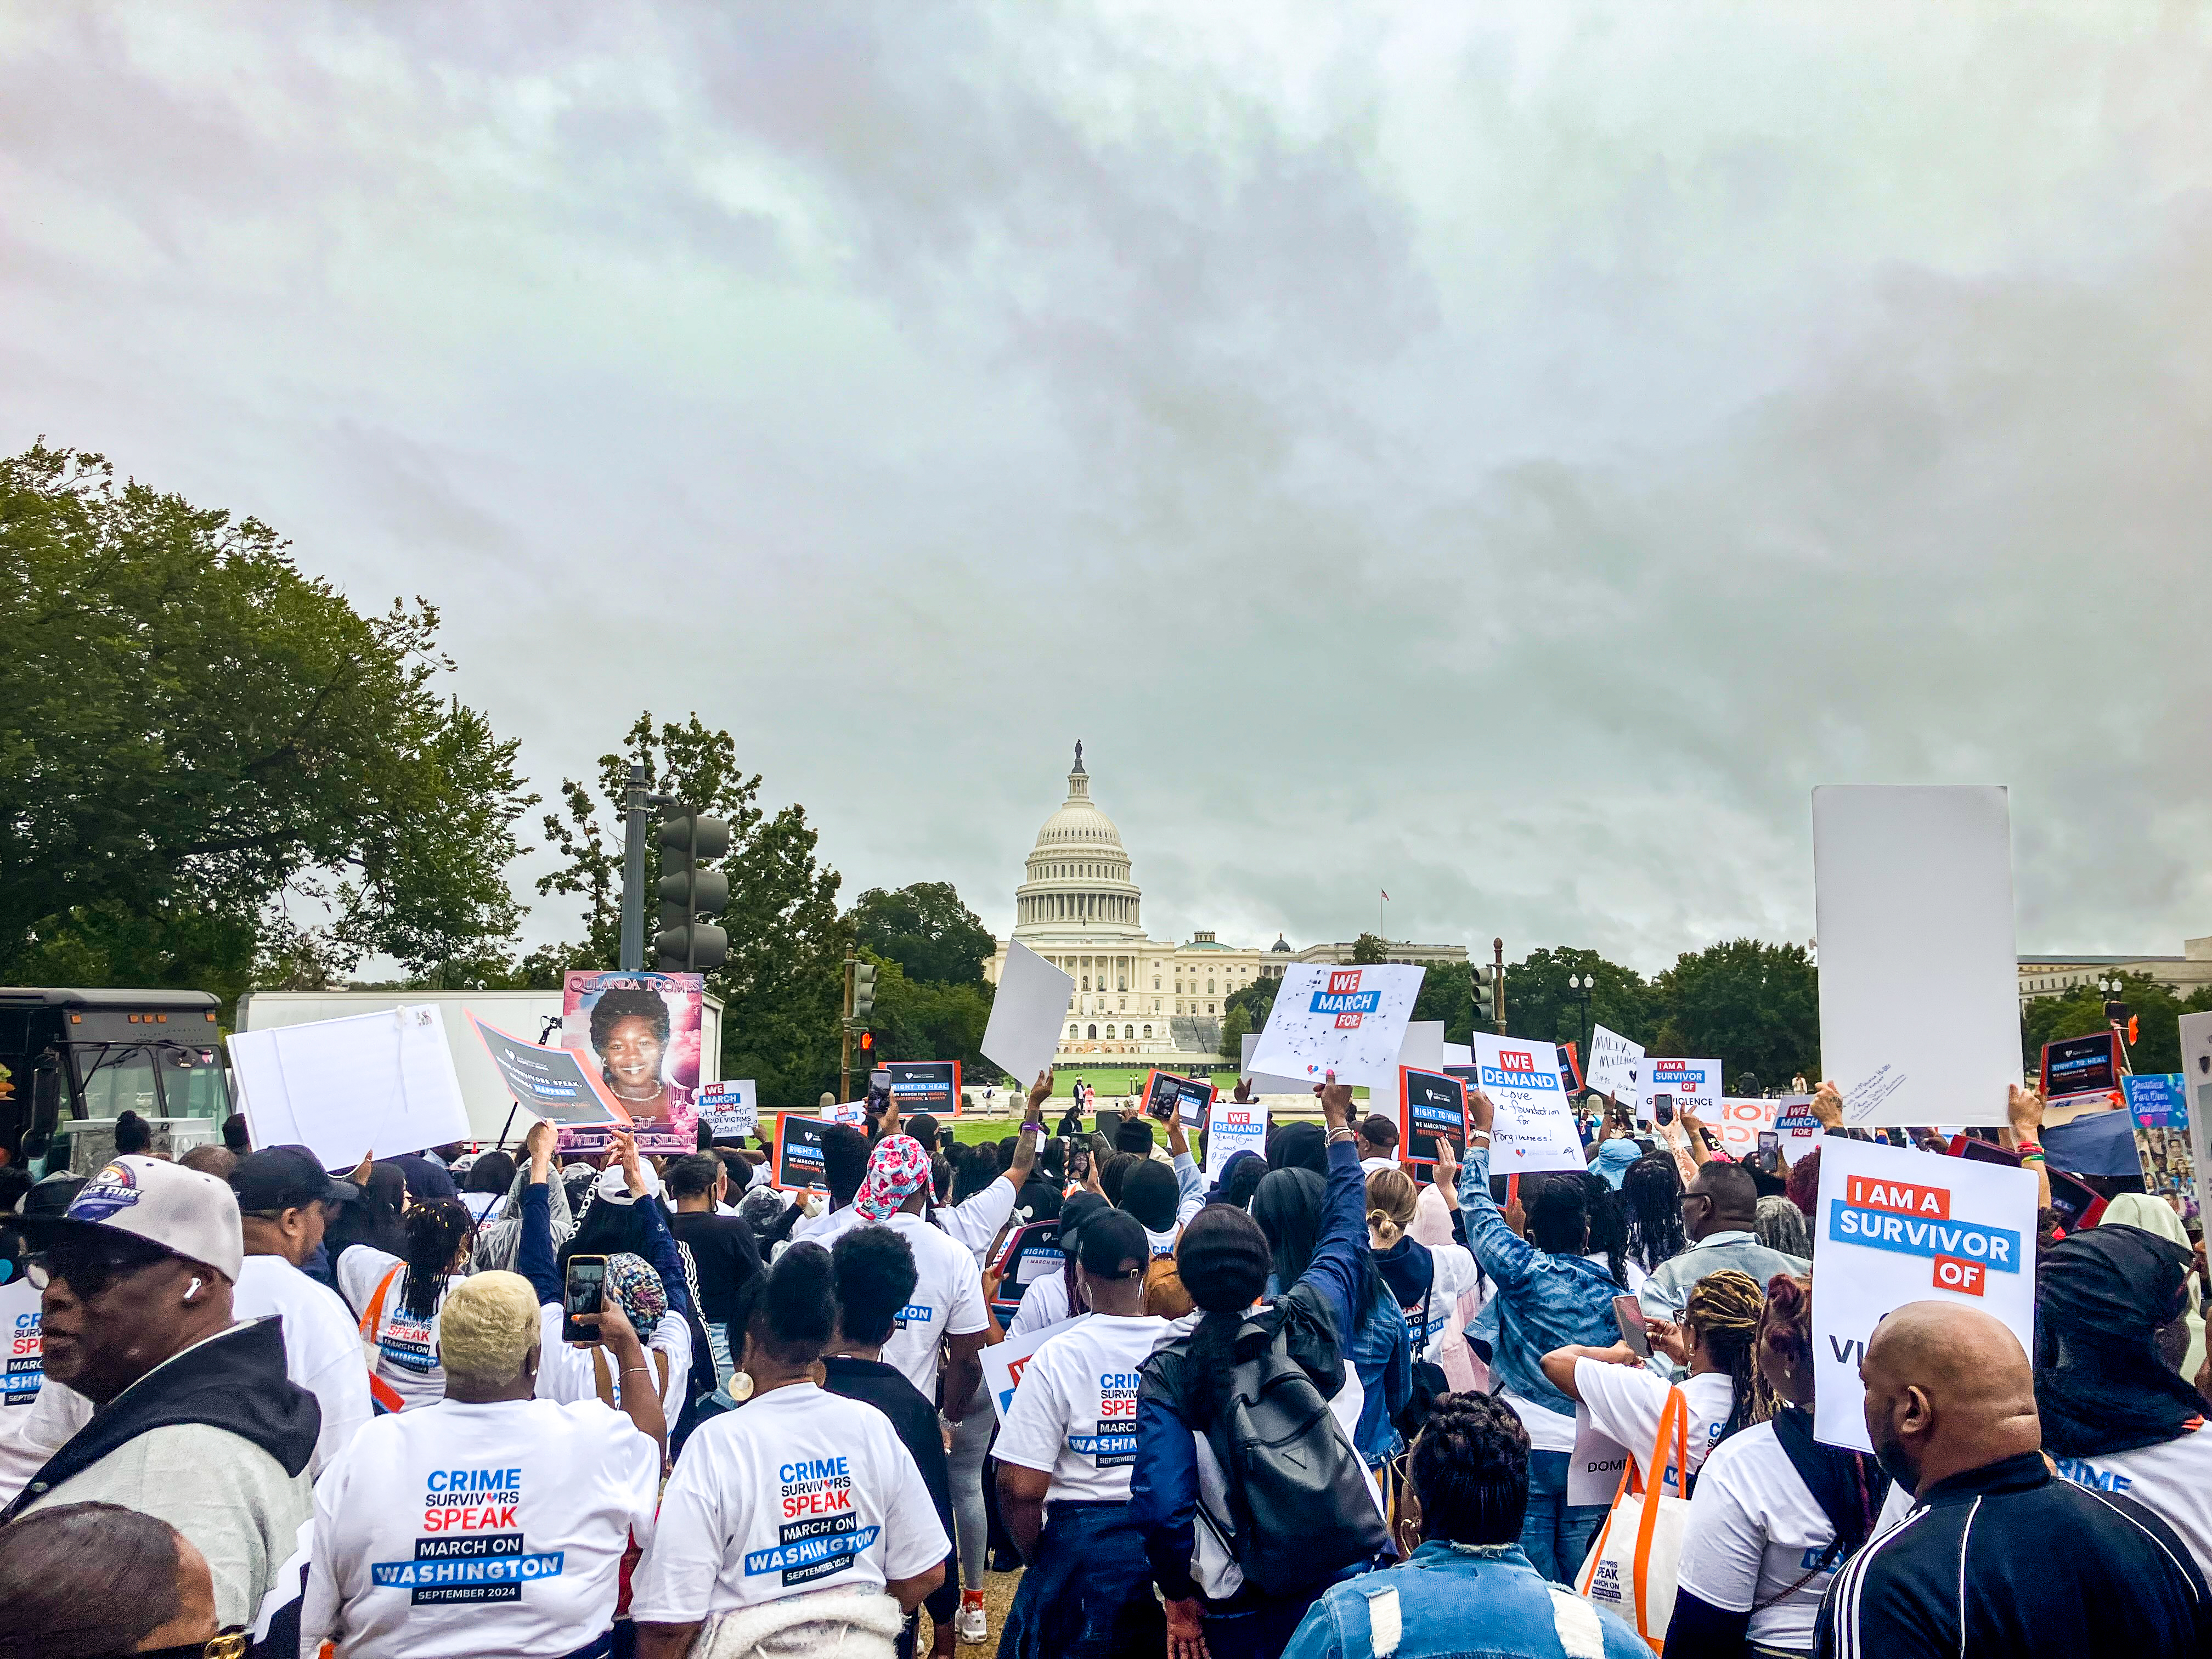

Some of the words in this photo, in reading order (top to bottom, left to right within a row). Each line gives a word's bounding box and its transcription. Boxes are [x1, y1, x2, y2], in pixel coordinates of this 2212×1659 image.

[644, 977, 699, 994] TOOMBS
[1334, 973, 1358, 991] WE
[1318, 994, 1373, 1011] MARCH
[1338, 1014, 1359, 1027] FOR:
[1502, 1053, 1531, 1069] WE
[1484, 1069, 1554, 1087] DEMAND
[1656, 1073, 1702, 1081] SURVIVOR
[707, 1085, 723, 1094] WE
[1500, 1088, 1532, 1101] Love
[702, 1094, 737, 1104] MARCH
[1509, 1099, 1560, 1115] foundation
[838, 1106, 848, 1114] WE
[1229, 1113, 1248, 1122] WE
[1415, 1107, 1436, 1118] RIGHT
[1437, 1110, 1446, 1119] TO
[1447, 1113, 1460, 1123] HEAL
[1791, 1107, 1806, 1115] WE
[1215, 1122, 1261, 1133] DEMAND
[1516, 1115, 1530, 1125] for
[1781, 1117, 1818, 1127] MARCH
[789, 1145, 814, 1156] RIGHT
[797, 1158, 815, 1166] MARCH
[1855, 1182, 1863, 1202] I
[1868, 1184, 1914, 1210] AM
[1920, 1193, 1941, 1214] A
[1839, 1210, 2011, 1262] SURVIVOR
[1939, 1262, 1980, 1288] OF
[388, 1325, 431, 1342] SPEAK
[416, 1345, 428, 1354] ON
[10, 1359, 43, 1372] MARC
[1102, 1400, 1136, 1416] SPE
[780, 1457, 849, 1483] CRIME
[427, 1469, 521, 1492] CRIME
[783, 1488, 851, 1518] SPEAK
[424, 1505, 518, 1532] SPEAK
[784, 1520, 832, 1542] MARCH
[836, 1516, 855, 1531] ON
[420, 1539, 487, 1556] MARCH
[493, 1538, 520, 1552] ON
[749, 1529, 876, 1572] WASHINGTON
[376, 1556, 559, 1584] WASHINGTON
[787, 1561, 834, 1581] SEPTEMBER
[832, 1556, 850, 1569] 2024
[417, 1588, 484, 1600] SEPTEMBER
[488, 1587, 516, 1597] 2024
